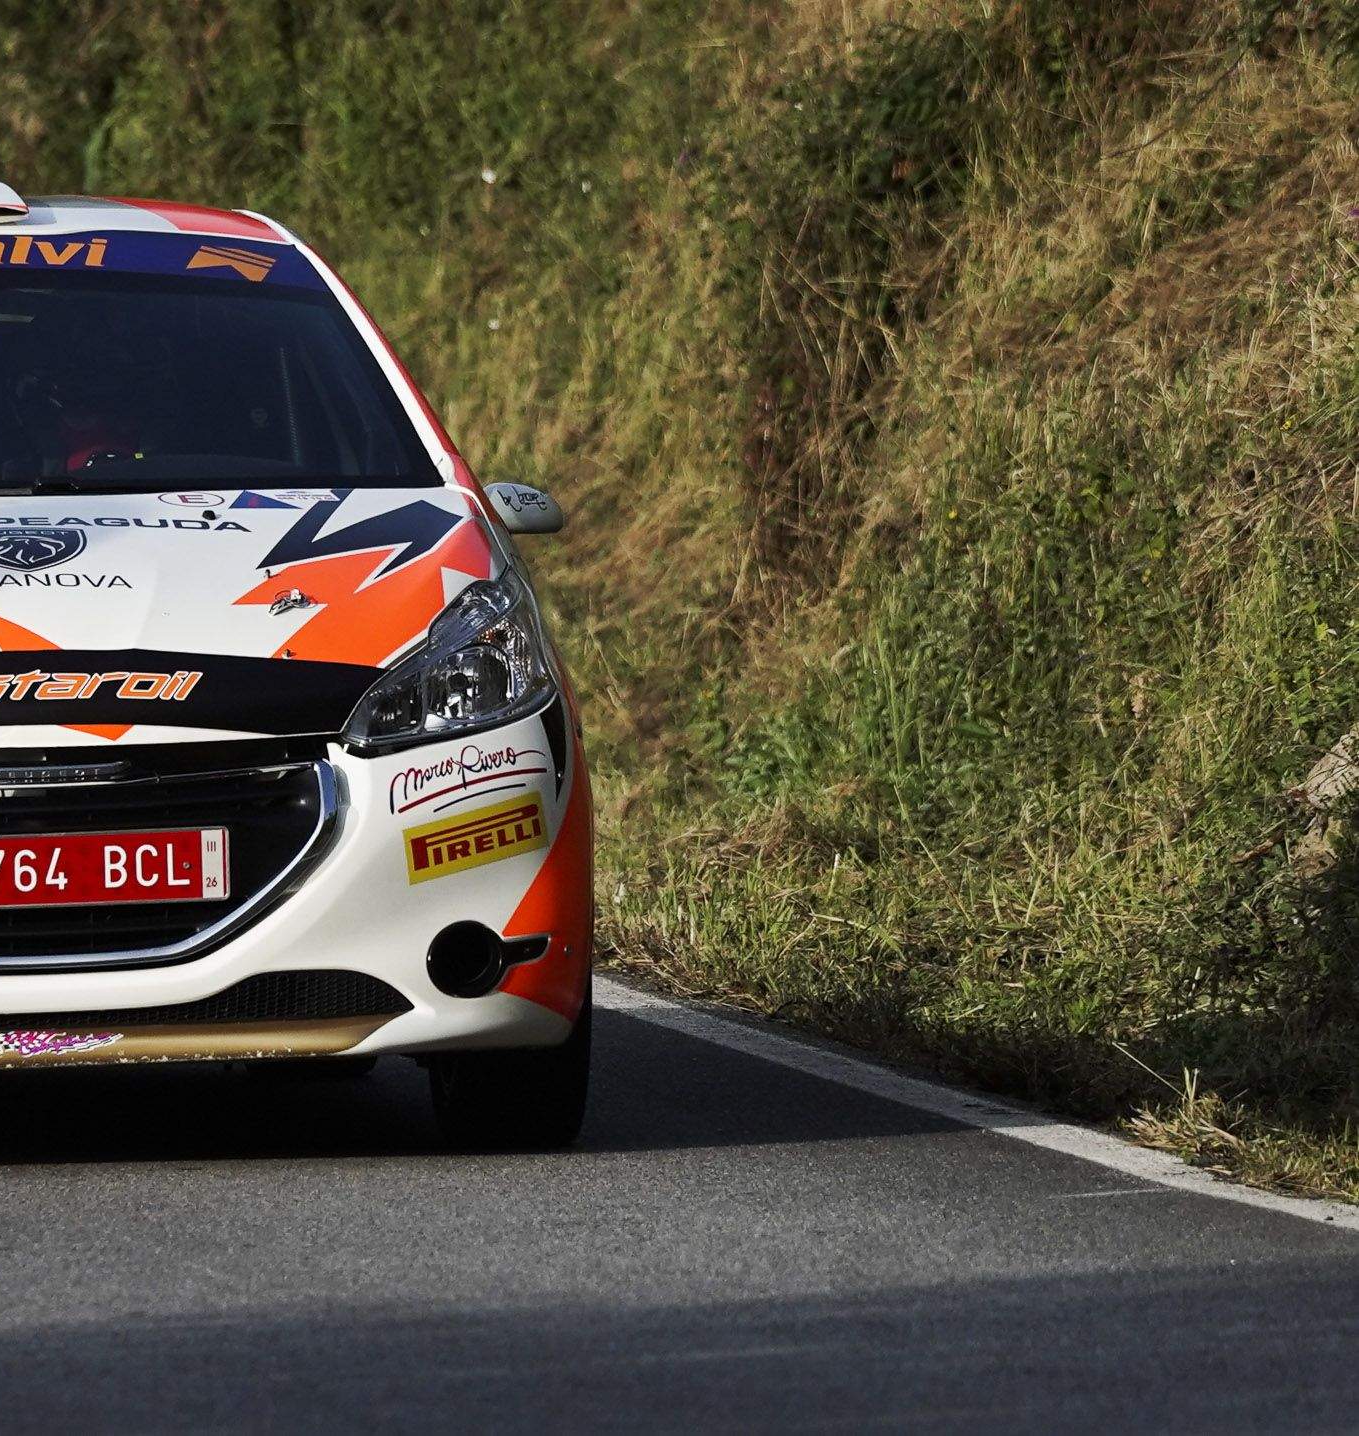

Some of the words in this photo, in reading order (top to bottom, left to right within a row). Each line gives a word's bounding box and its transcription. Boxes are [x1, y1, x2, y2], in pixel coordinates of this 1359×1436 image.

[389, 757, 454, 815] Marco
[452, 745, 546, 790] Rivero
[206, 840, 217, 852] III
[410, 804, 543, 872] PIRELLI
[103, 842, 191, 889] BCL
[205, 876, 218, 888] 26
